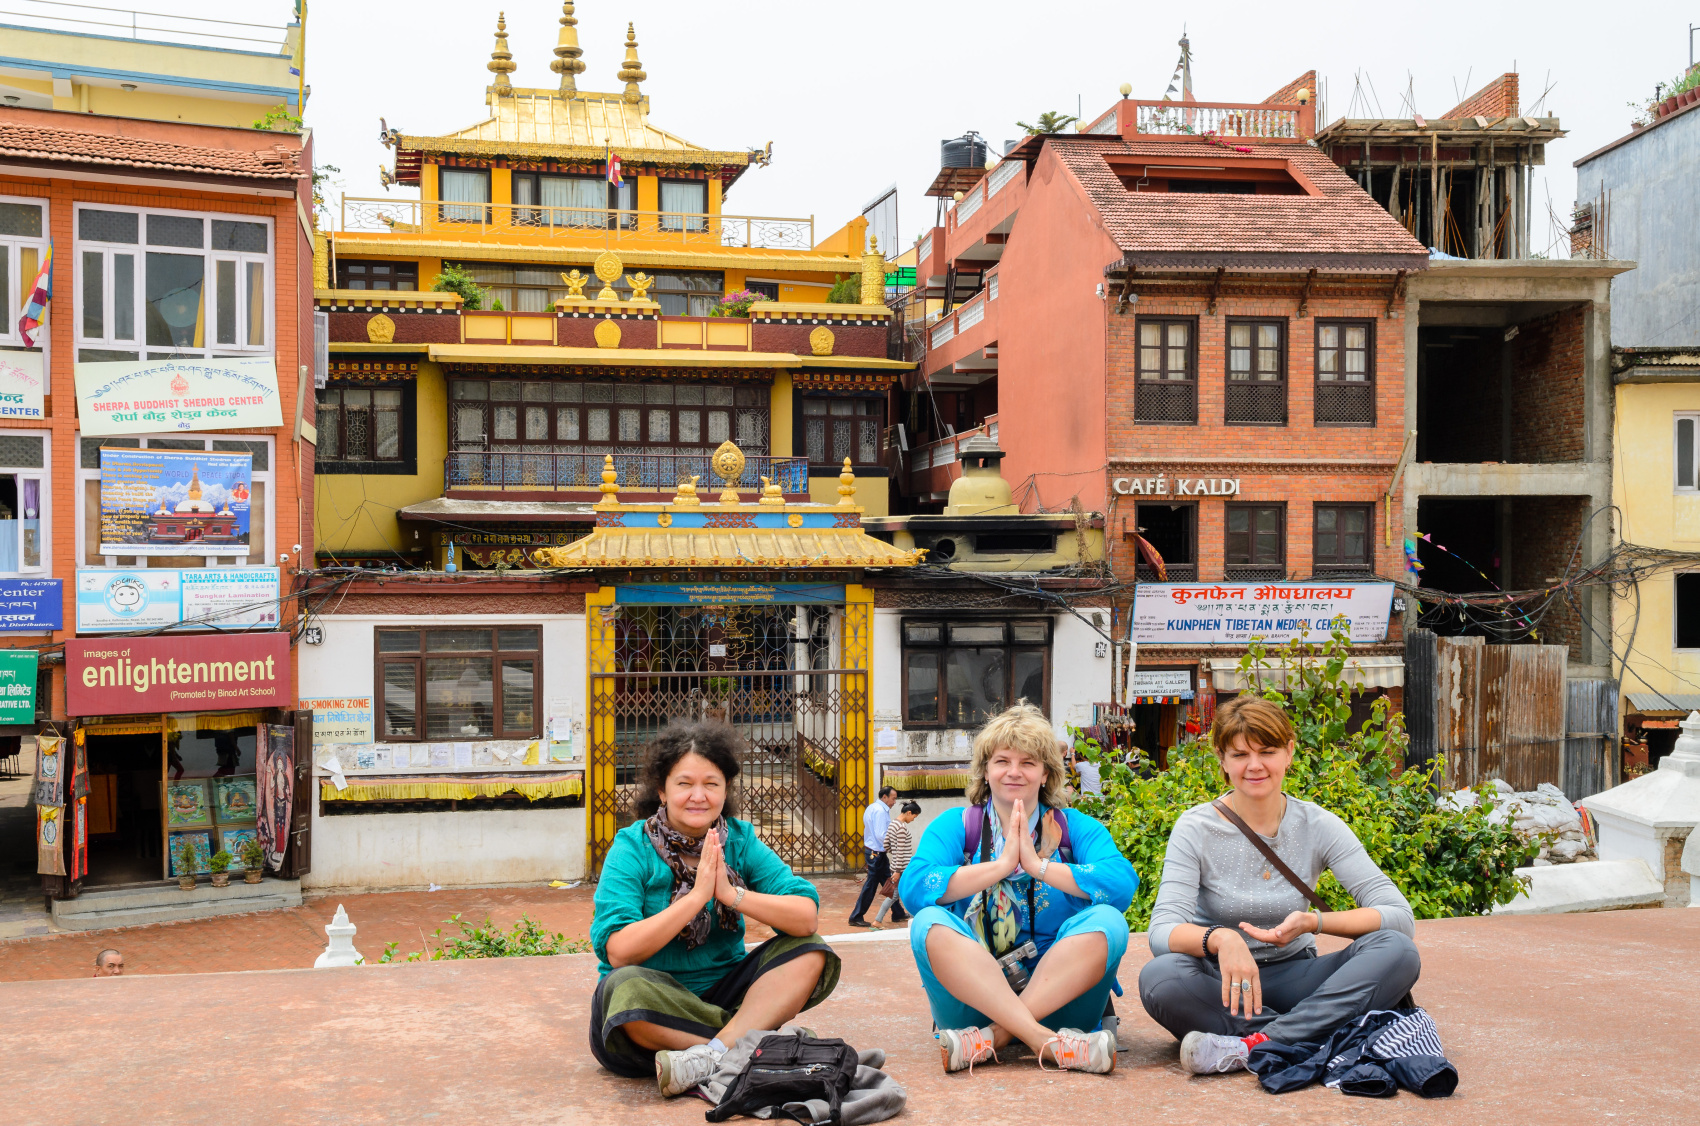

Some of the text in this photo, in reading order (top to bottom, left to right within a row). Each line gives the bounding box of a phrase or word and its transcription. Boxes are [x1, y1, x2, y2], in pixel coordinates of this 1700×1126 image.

[93, 396, 263, 412] SHERPA BUDDHIST SHEDRUB CENTER
[0, 407, 40, 416] ENTER
[165, 471, 189, 479] WORLD
[202, 472, 222, 480] PEACE
[1113, 473, 1241, 496] CAFÉ KALDI
[110, 578, 145, 590] MOCHIKO
[1171, 585, 1247, 604] कुनफेन
[1166, 619, 1221, 631] KUNPHEN
[1225, 619, 1273, 631] TIBETAN
[1276, 619, 1312, 631] MEDICL
[83, 648, 131, 660] images of
[82, 655, 276, 693] enlightenment
[170, 687, 276, 701] (Promoted by Binod Art School)
[19, 700, 31, 708] LTD.
[299, 698, 370, 710] NO SMOKING ZONE
